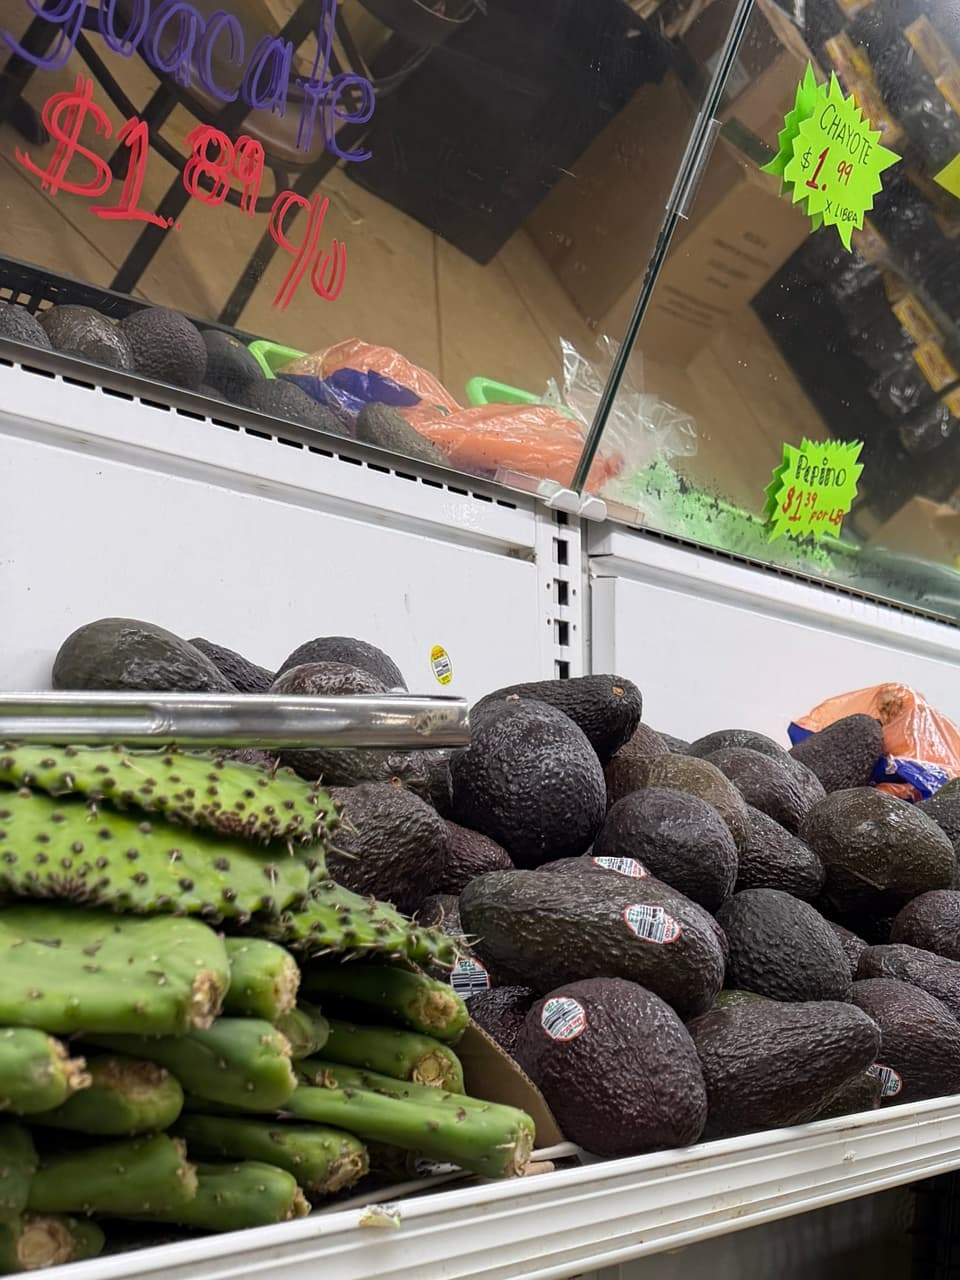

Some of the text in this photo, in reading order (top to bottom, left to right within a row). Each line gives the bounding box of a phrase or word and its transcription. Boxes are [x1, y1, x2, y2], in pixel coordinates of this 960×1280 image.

[820, 103, 873, 166] CHAYOTE
[834, 203, 858, 224] LIBRA
[795, 454, 847, 487] Pepino
